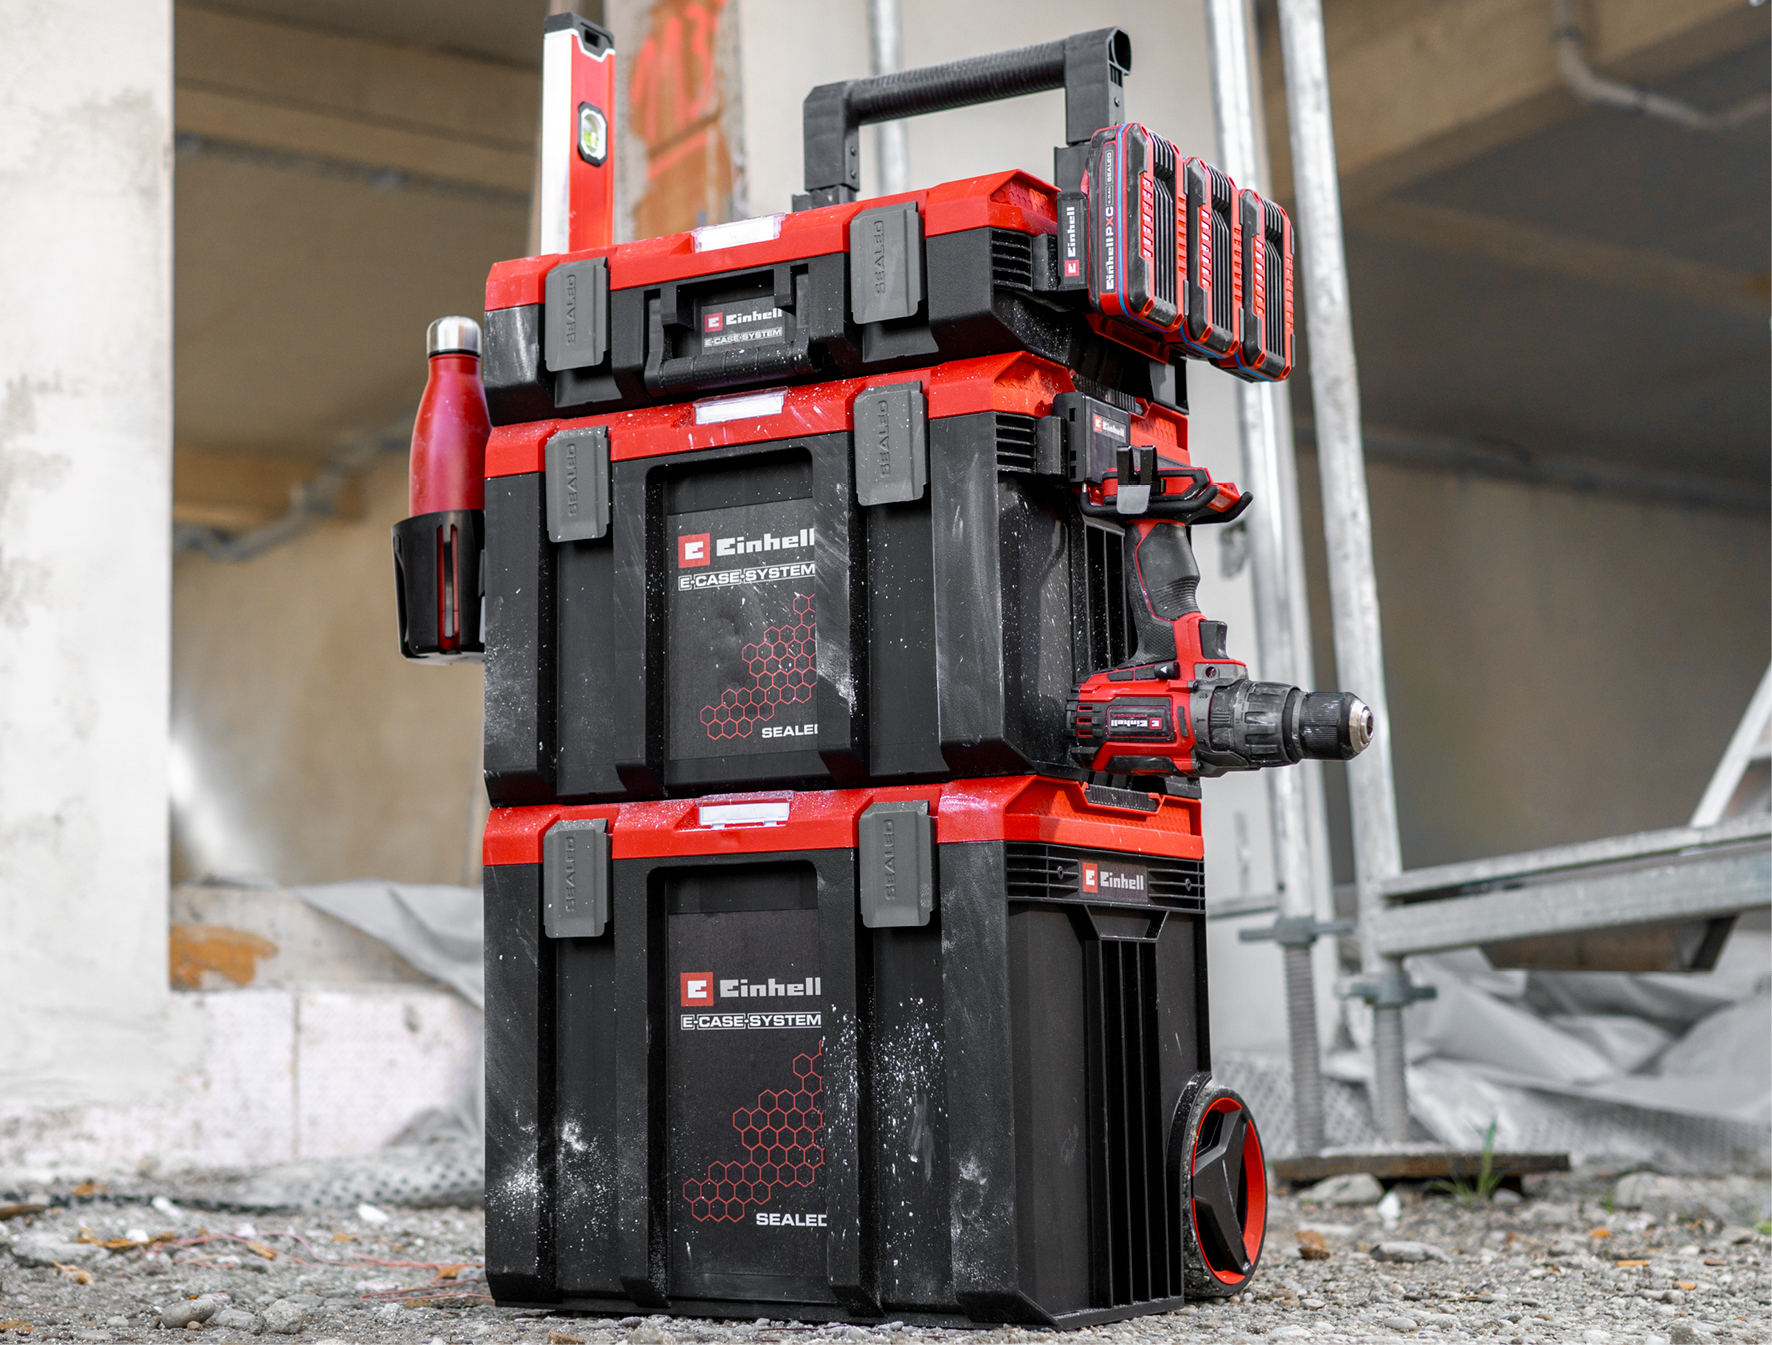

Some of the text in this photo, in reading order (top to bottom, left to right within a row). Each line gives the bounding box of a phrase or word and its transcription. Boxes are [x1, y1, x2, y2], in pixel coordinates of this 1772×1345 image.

[873, 220, 885, 296] SEALED
[1066, 206, 1076, 257] Einhell
[567, 274, 576, 345] SEALED
[725, 307, 783, 326] Einhell
[877, 400, 890, 478] SEALED
[567, 443, 577, 517] SEALED
[716, 528, 815, 556] Einhell
[762, 724, 818, 738] SEALE
[565, 836, 575, 912] SEALED
[884, 819, 896, 900] SEALED
[1100, 871, 1144, 891] Einhell
[719, 977, 821, 997] Einhell
